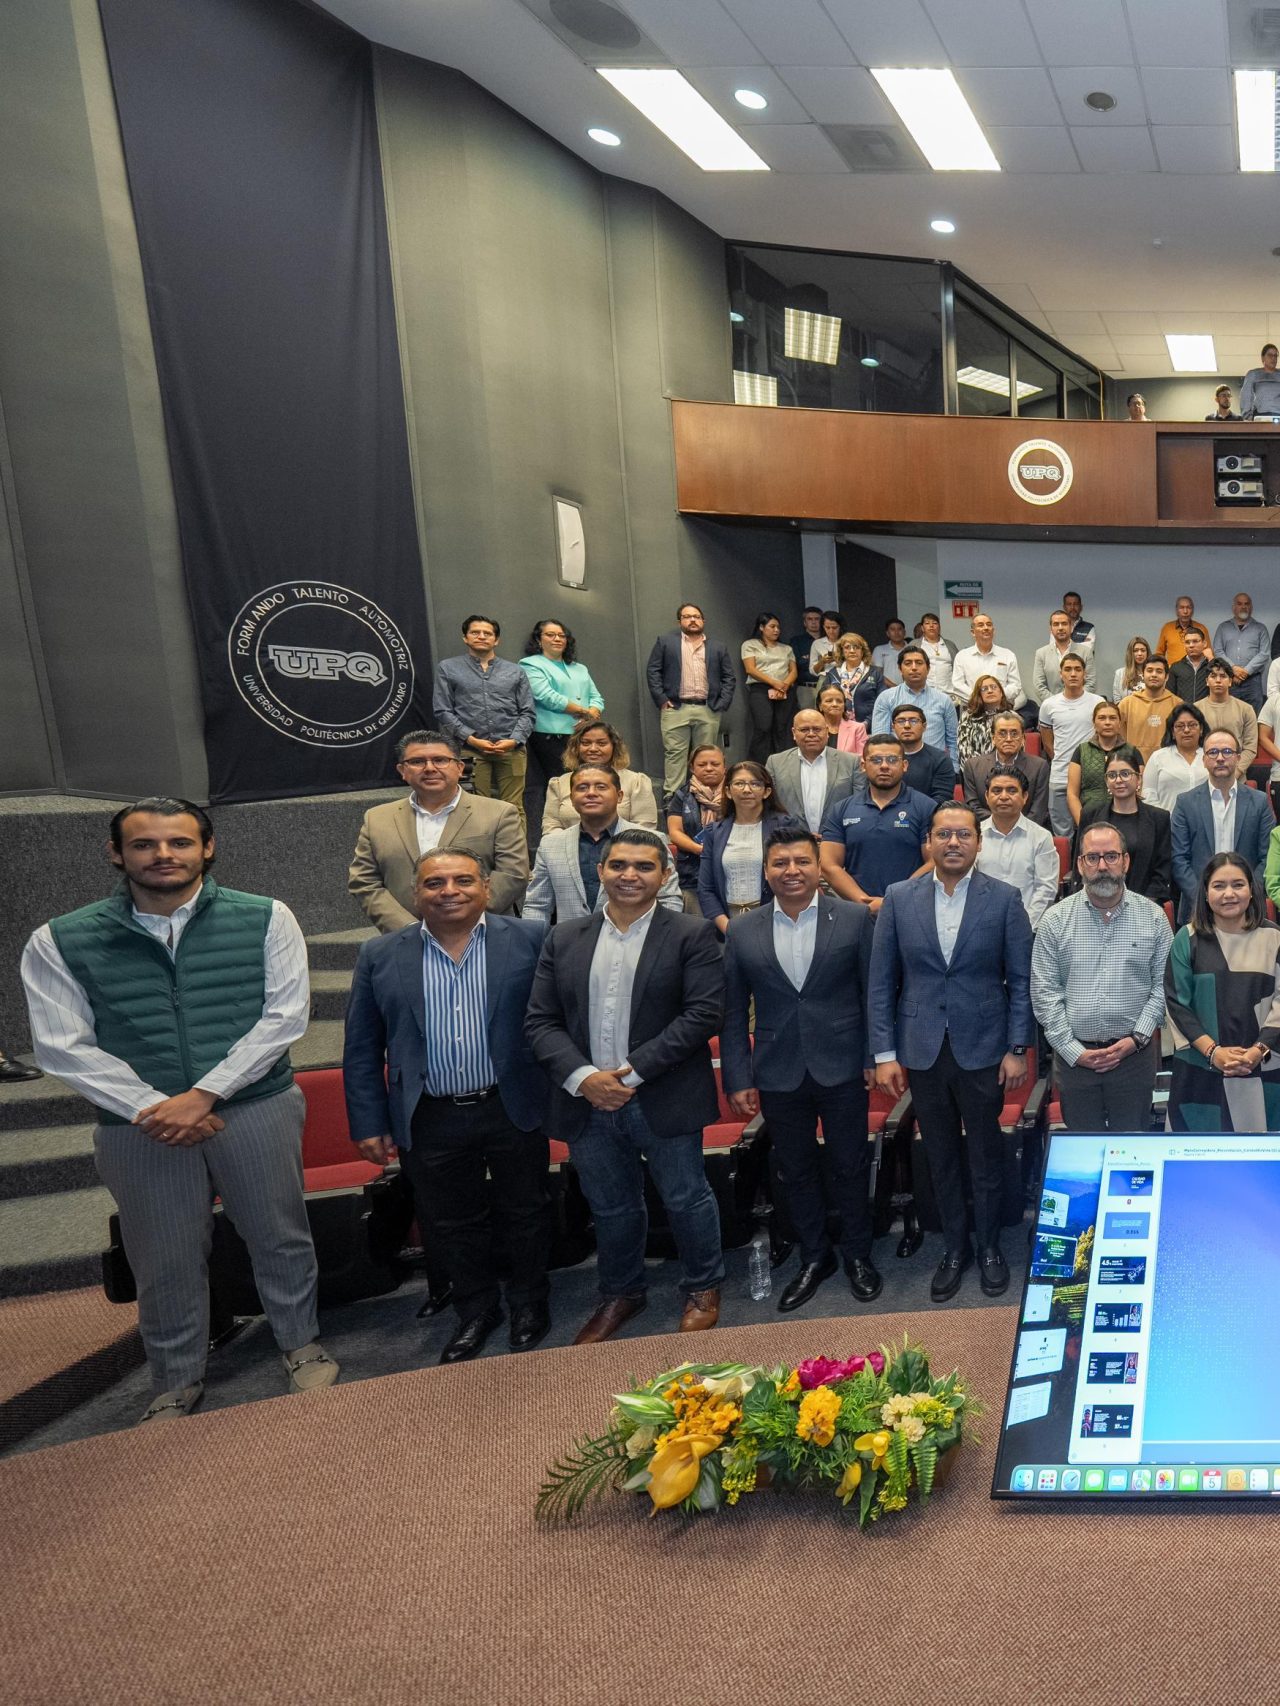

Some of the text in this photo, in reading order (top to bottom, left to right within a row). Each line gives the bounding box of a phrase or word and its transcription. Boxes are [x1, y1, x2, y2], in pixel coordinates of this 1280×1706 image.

[1020, 466, 1061, 482] UPQ
[291, 588, 349, 604] TALENTO
[358, 606, 409, 670] AUTOMOTRIZ
[268, 645, 388, 687] UPQ
[243, 675, 407, 740] UNIVERSIDAD POLITÉCNICA DE QUERÉTARO
[1209, 1478, 1216, 1488] 5
